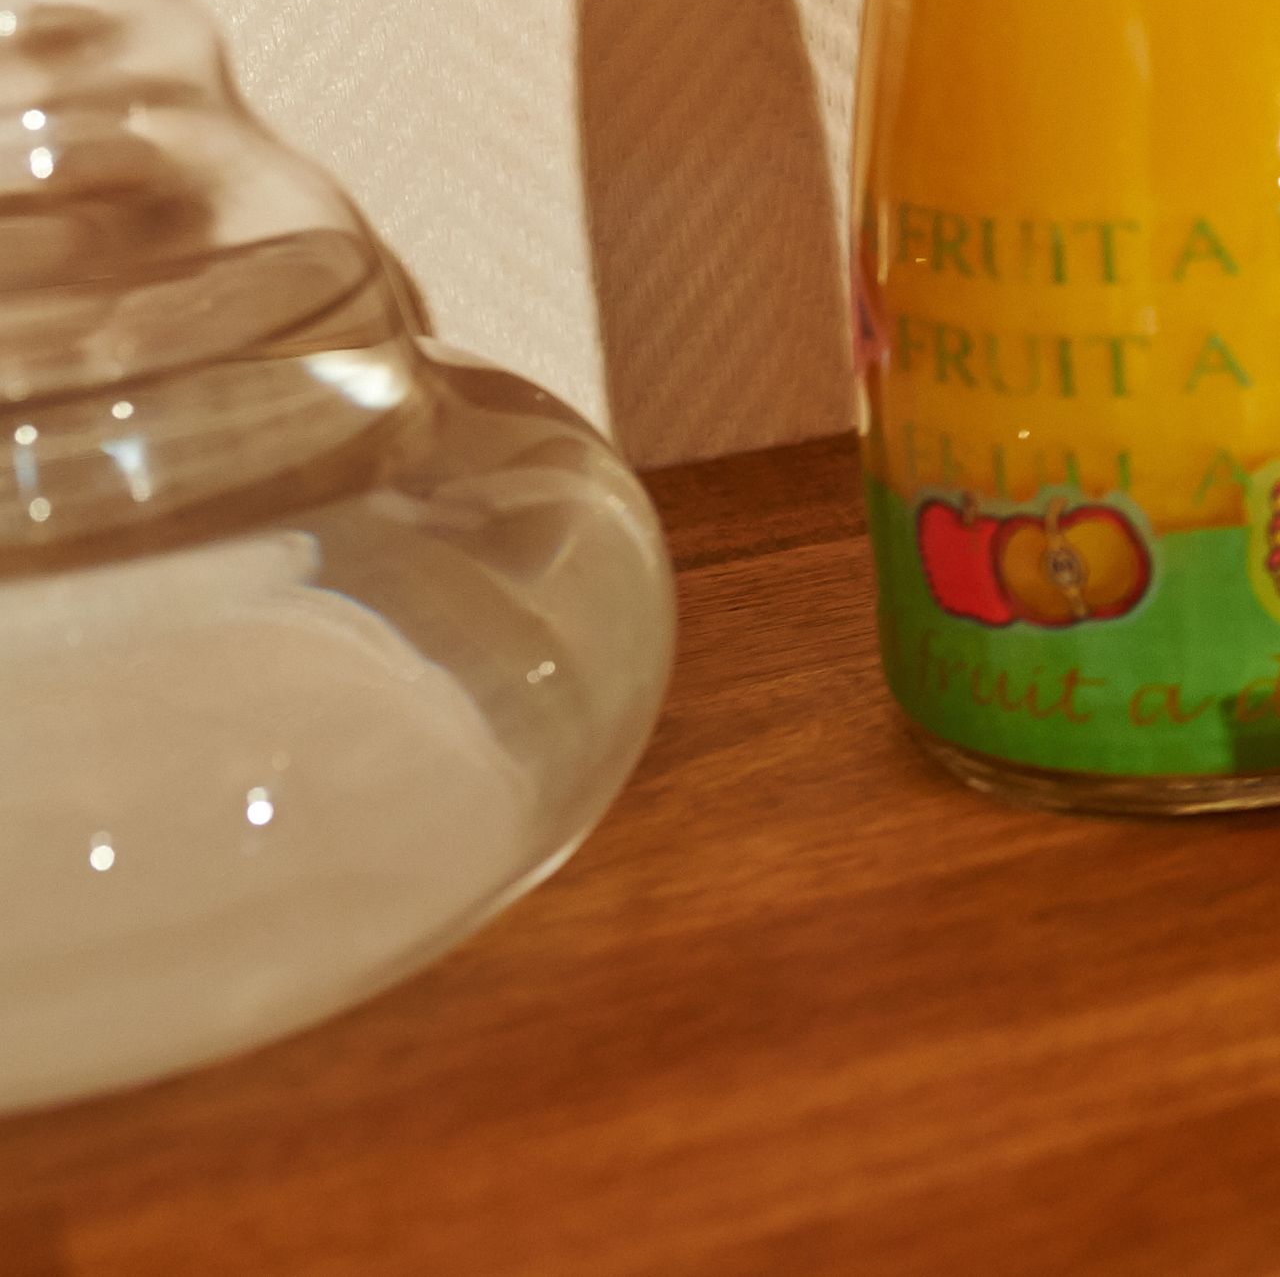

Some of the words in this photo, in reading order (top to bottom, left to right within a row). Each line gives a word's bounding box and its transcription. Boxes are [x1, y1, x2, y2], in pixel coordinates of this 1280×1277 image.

[896, 200, 1142, 287] FRUIT
[1171, 216, 1242, 284] A
[897, 310, 1152, 399] FRUIT
[1182, 332, 1255, 395] A
[1127, 680, 1218, 729] a
